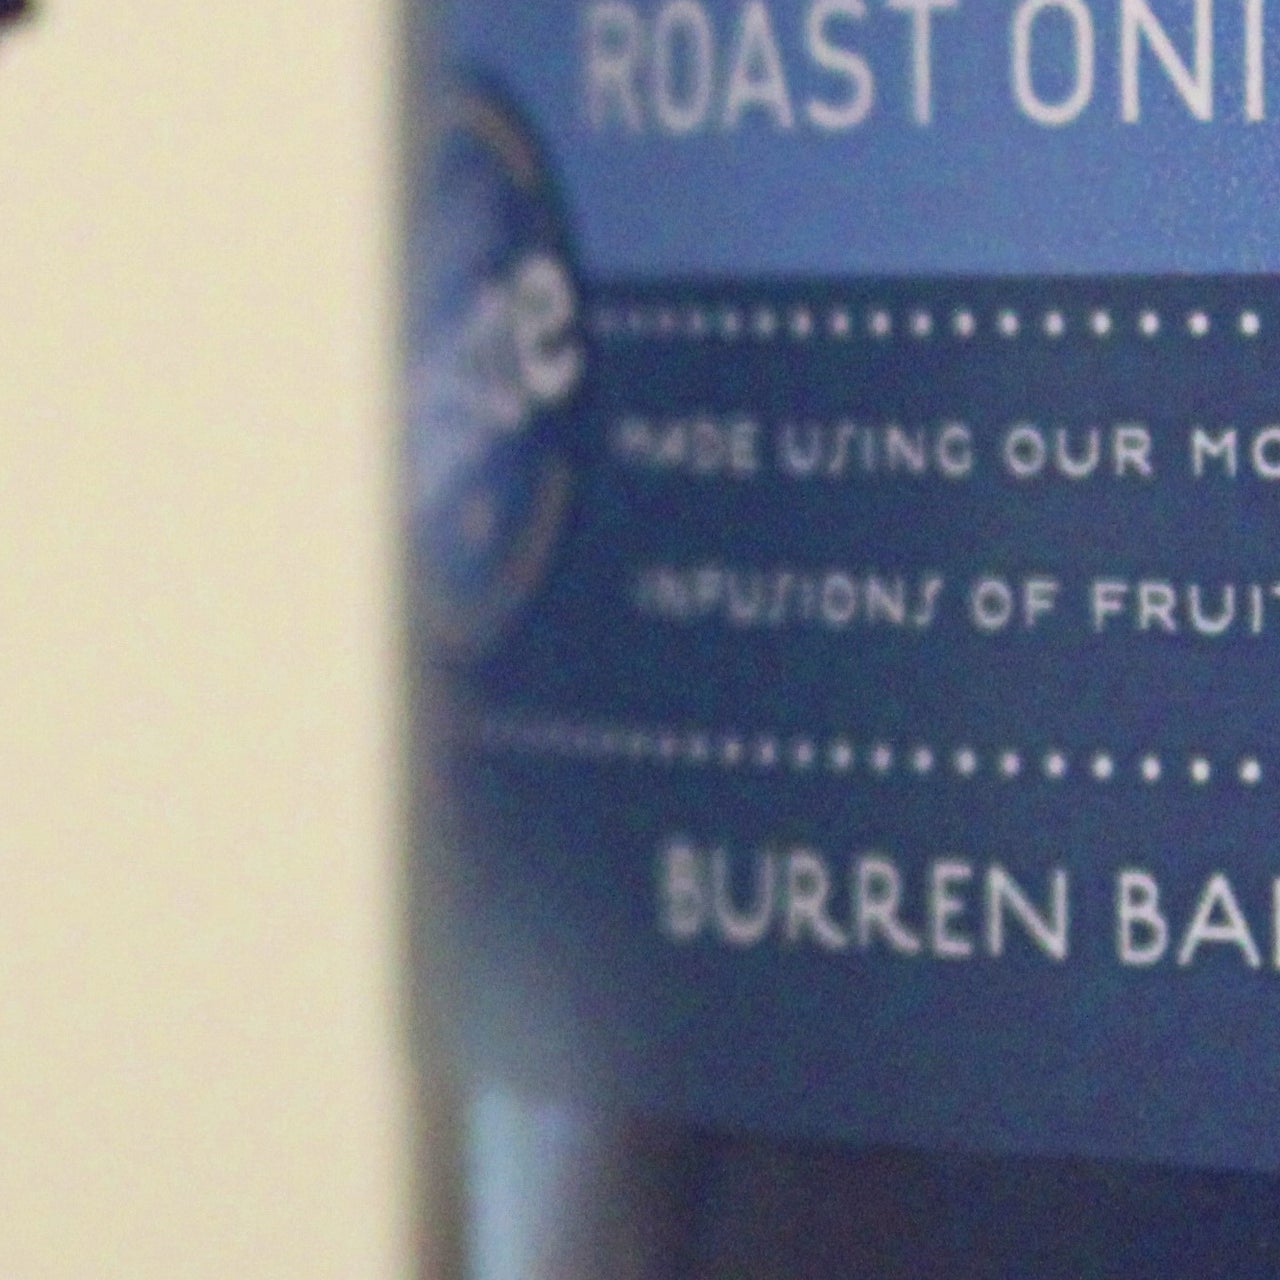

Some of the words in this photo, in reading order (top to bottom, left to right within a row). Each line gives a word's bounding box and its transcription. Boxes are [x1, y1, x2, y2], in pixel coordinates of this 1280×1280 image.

[614, 416, 757, 474] MADE
[782, 421, 974, 477] USING
[1004, 425, 1153, 477] OUR
[640, 566, 943, 627] INFUSIONS
[971, 576, 1058, 630] OF
[662, 840, 1068, 962] BURREN
[1116, 870, 1280, 968] BA
